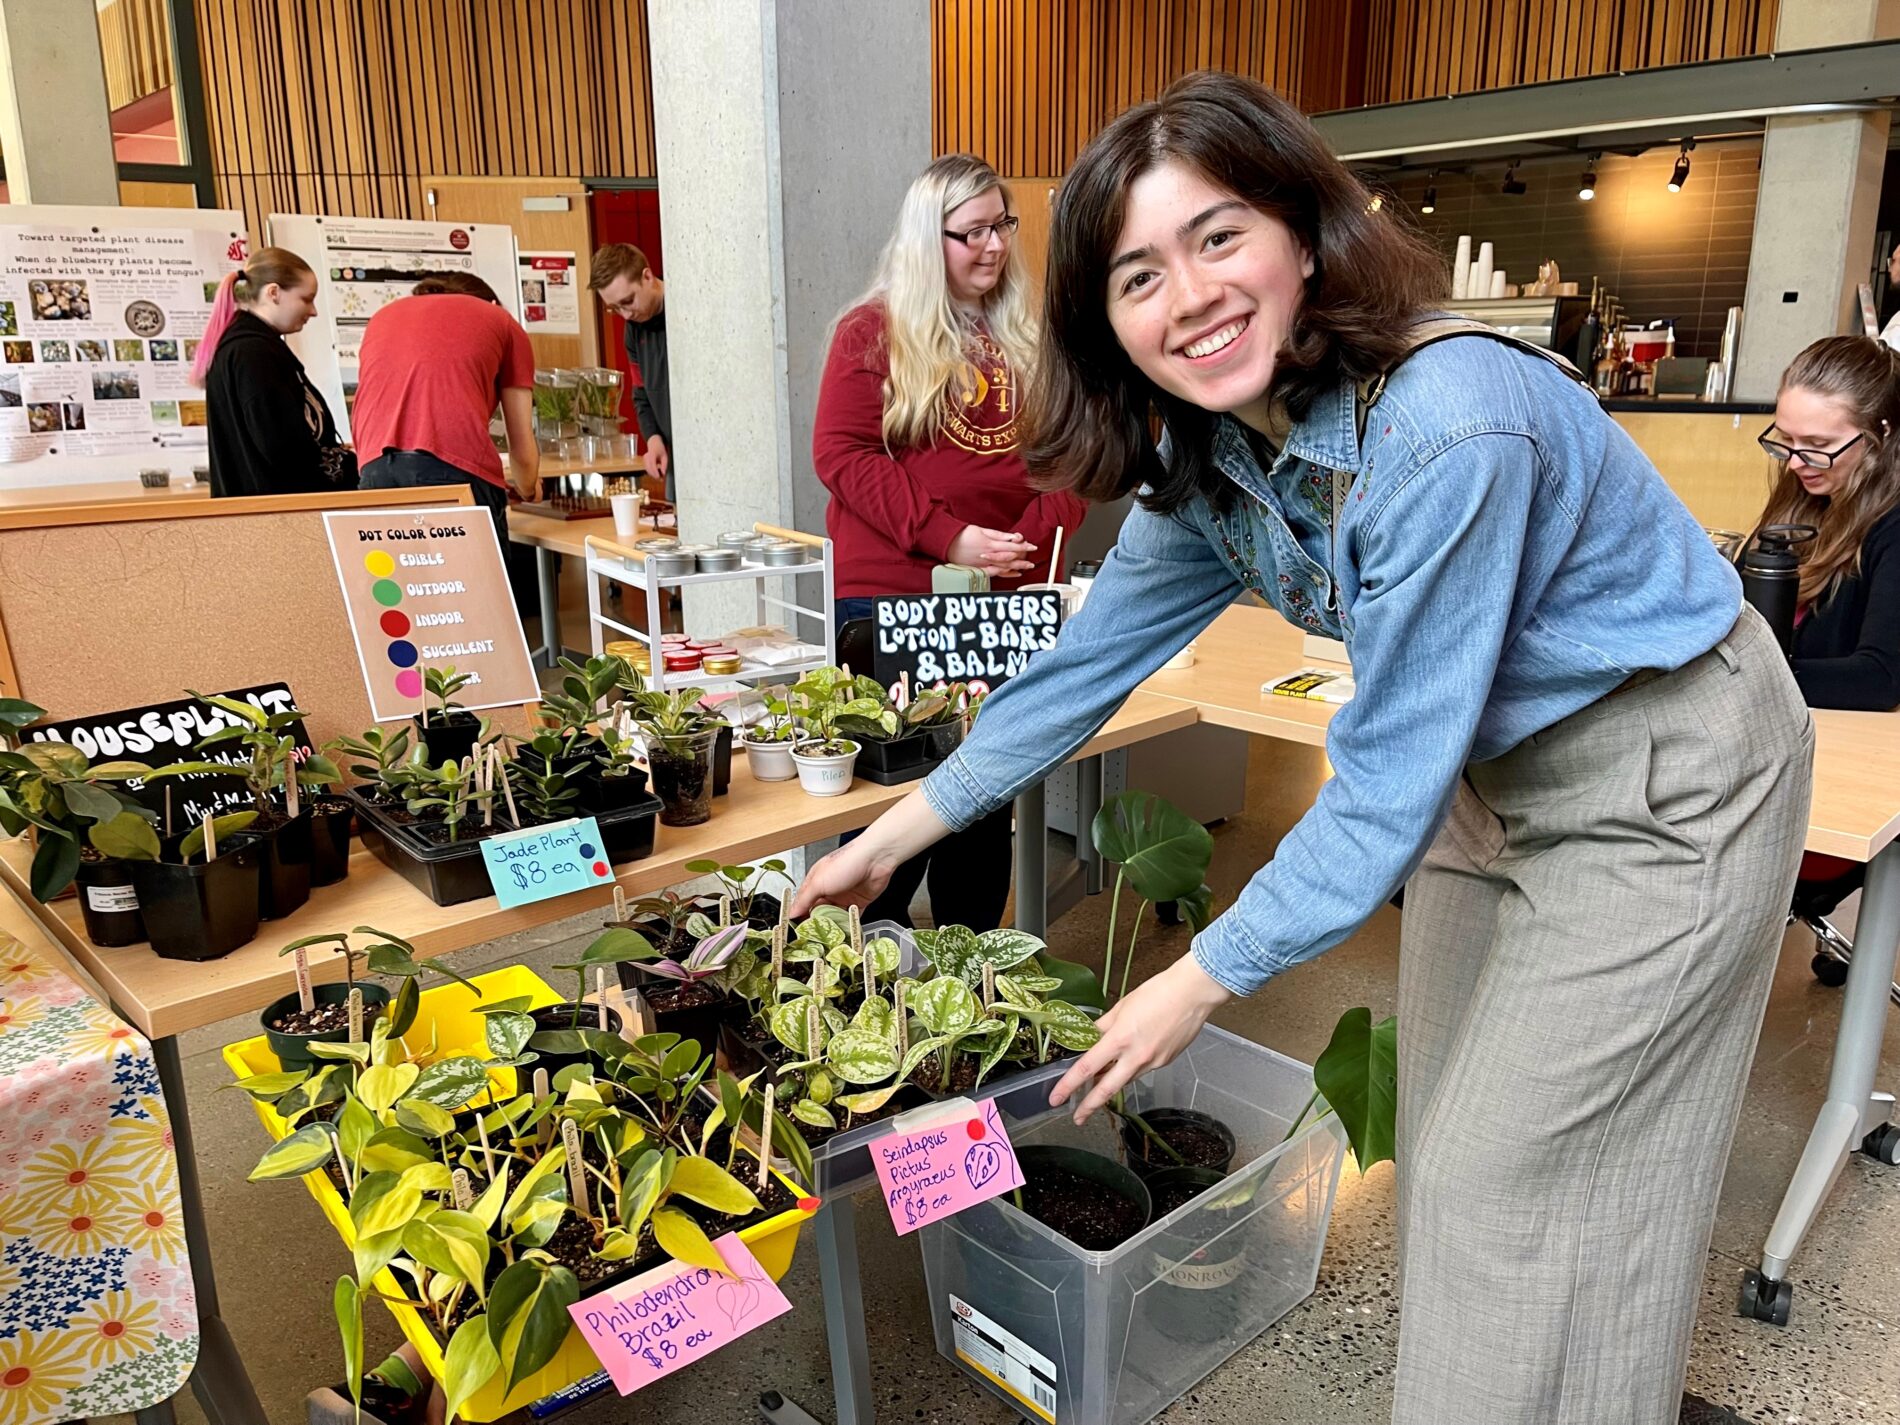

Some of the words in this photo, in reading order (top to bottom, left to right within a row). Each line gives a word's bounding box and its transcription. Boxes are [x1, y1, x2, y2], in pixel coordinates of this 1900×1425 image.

[18, 234, 54, 242] Toward
[60, 236, 105, 246] targeted
[110, 236, 140, 246] plant
[145, 236, 184, 244] disease
[6, 266, 52, 275] infected
[138, 268, 160, 276] mold
[16, 256, 40, 264] When
[45, 256, 57, 264] do
[62, 256, 114, 266] blueberry
[120, 258, 154, 266] plants
[159, 258, 192, 266] become
[358, 530, 382, 541] DOT
[387, 528, 426, 540] COLOR
[430, 526, 466, 538] CODES
[400, 553, 446, 567] EDIBLE
[406, 581, 466, 597] OUTDOOR
[416, 612, 464, 627] INDOOR
[878, 596, 939, 627] BODY
[946, 596, 1058, 625] BUTTERS
[422, 640, 494, 659] SUCCULENT
[916, 651, 944, 682] &
[494, 842, 539, 863] Jade
[540, 828, 582, 851] Plant
[510, 861, 546, 890] $8
[552, 862, 580, 874] ea
[890, 1157, 931, 1185] Pictus
[905, 1196, 928, 1226] $8
[932, 1193, 952, 1210] ea
[585, 1268, 724, 1336] Philodendron
[618, 1300, 696, 1355] Brazil
[642, 1340, 678, 1370] $8
[686, 1329, 712, 1348] ea
